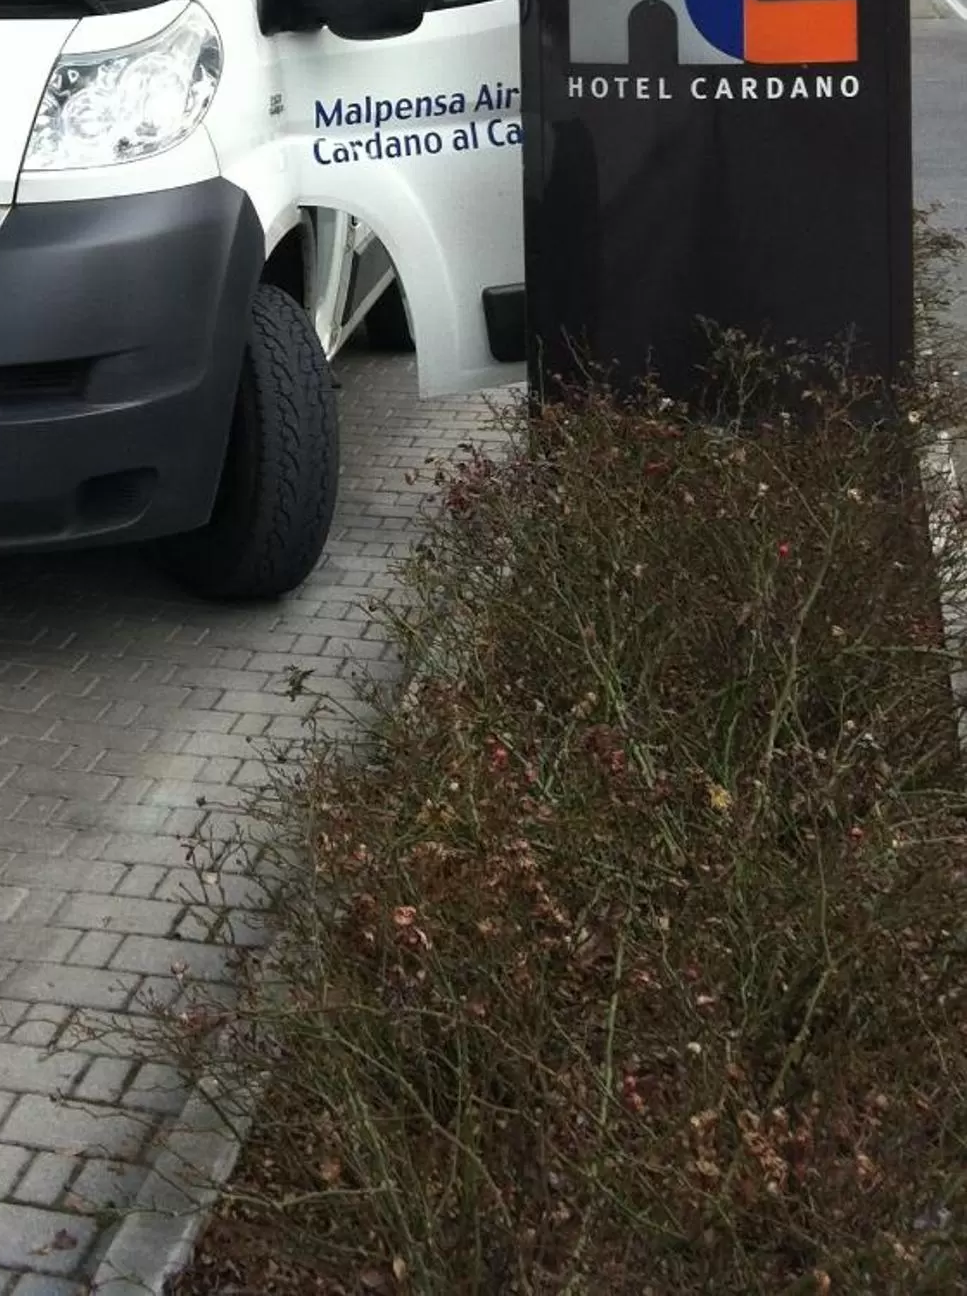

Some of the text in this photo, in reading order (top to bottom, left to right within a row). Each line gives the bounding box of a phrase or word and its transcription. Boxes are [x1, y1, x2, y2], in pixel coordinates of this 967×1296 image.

[567, 75, 860, 100] HOTEL CARDANO
[314, 91, 466, 130] Malpensa
[313, 130, 443, 165] Cardano
[452, 120, 479, 151] al
